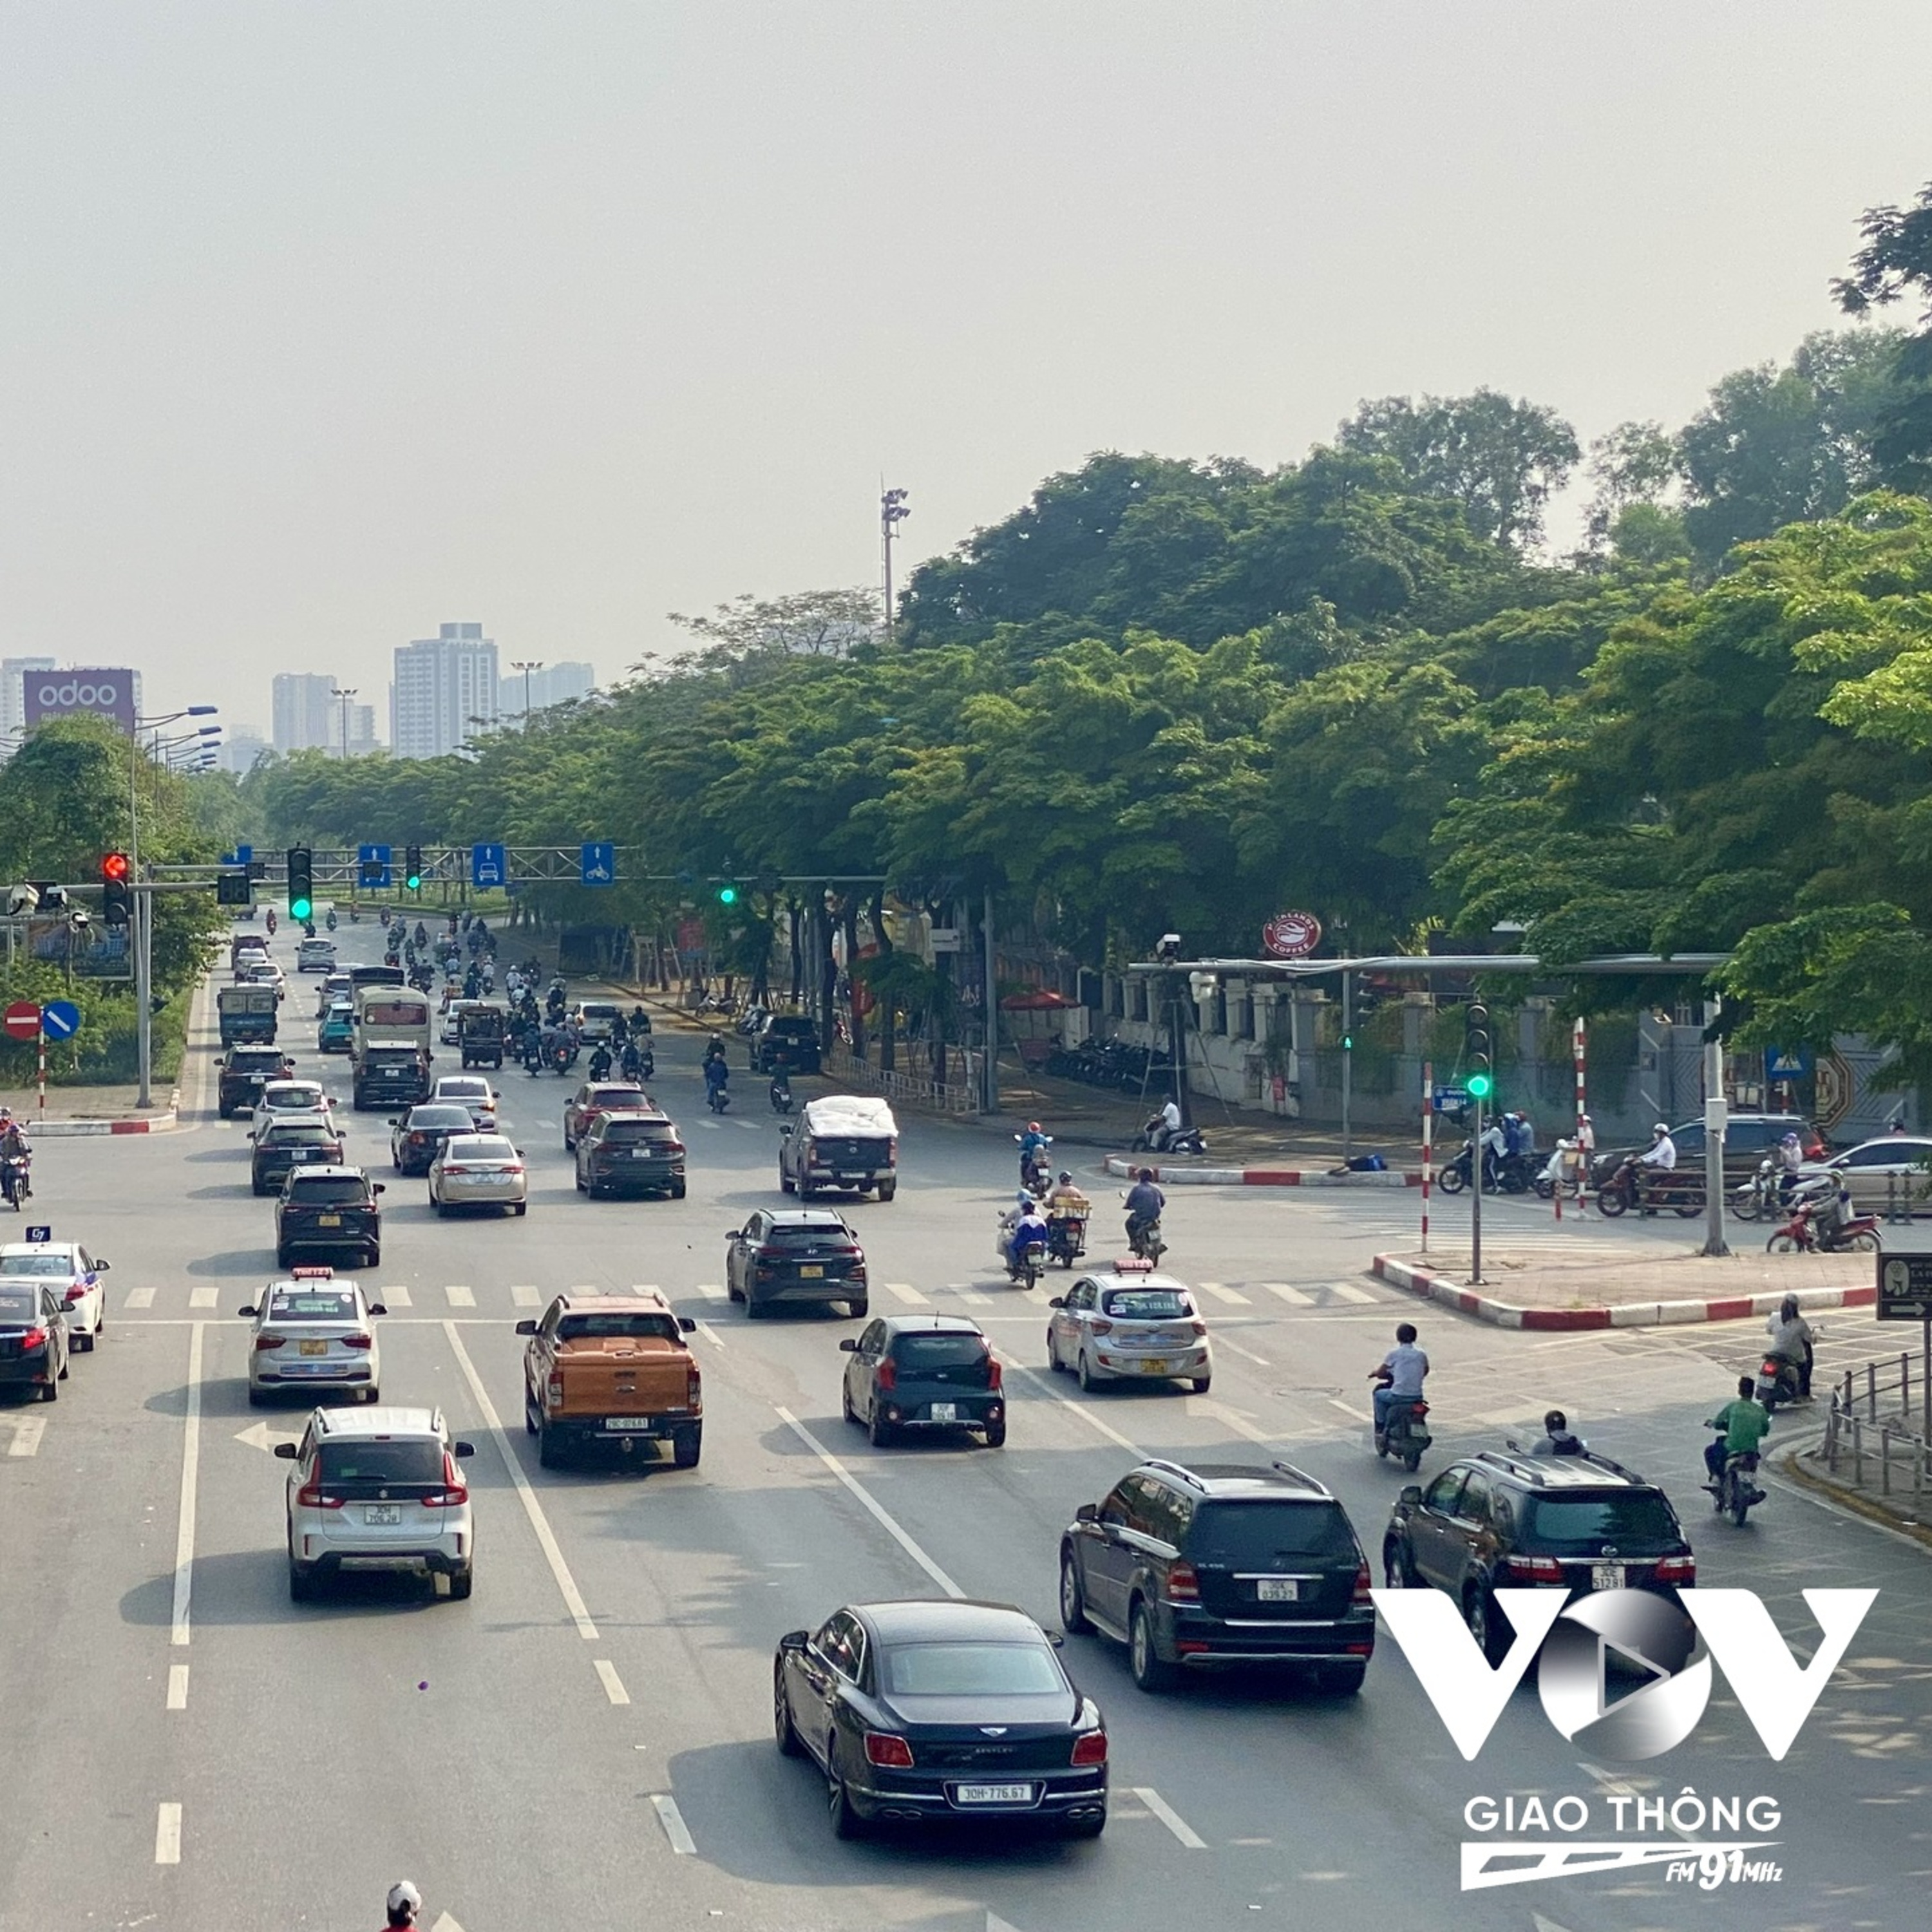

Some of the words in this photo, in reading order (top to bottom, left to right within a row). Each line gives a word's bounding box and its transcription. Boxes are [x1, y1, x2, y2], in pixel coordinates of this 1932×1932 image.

[39, 679, 117, 706] odoo
[1273, 943, 1309, 953] COFFEE
[964, 1787, 1025, 1800] 30H-776.67
